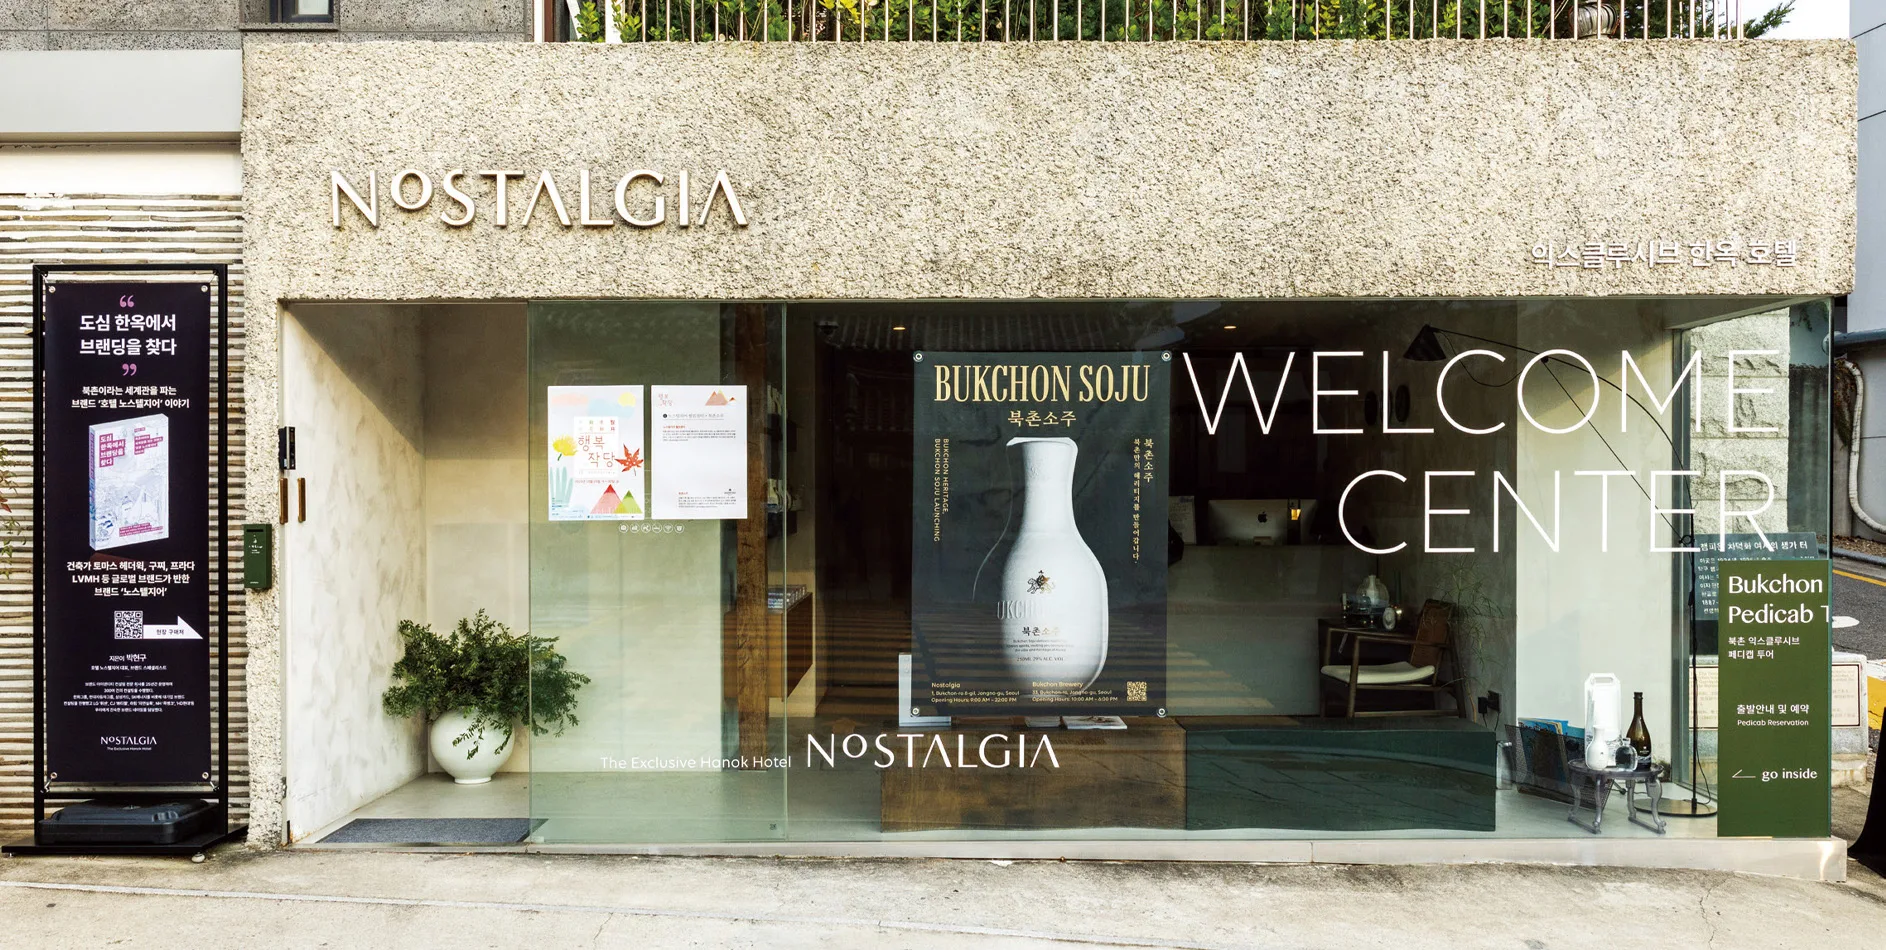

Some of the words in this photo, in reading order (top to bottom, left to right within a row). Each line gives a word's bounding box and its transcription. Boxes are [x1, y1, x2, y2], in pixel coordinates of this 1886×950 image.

[1531, 240, 1682, 271] 익스클루시브
[1689, 239, 1739, 268] 한옥
[1749, 240, 1797, 269] 호텔
[79, 314, 111, 332] 도심
[114, 313, 177, 332] 한옥에서
[79, 338, 142, 356] 브랜딩을
[145, 338, 177, 356] 찾다
[82, 385, 124, 396] 북촌이라는
[125, 385, 158, 396] 세계관을
[159, 385, 177, 396] 파는
[934, 364, 1071, 403] BUKCHON
[1079, 364, 1150, 403] SOJU
[1182, 348, 1780, 435] WELCOME
[71, 398, 97, 409] 브랜드
[164, 398, 190, 409] 이야기
[1007, 410, 1077, 428] 북촌소주
[578, 435, 605, 452] 행복
[588, 452, 615, 468] 작당
[942, 438, 950, 475] BUKCHON
[1143, 438, 1154, 483] 북촌소주
[1338, 469, 1777, 554] CENTER
[1781, 540, 1797, 550] 생가
[1799, 540, 1808, 549] 터
[66, 561, 92, 571] 건축가
[93, 561, 118, 571] 토마스
[148, 561, 169, 572] 구찌,
[170, 561, 195, 571] 프라다
[72, 574, 100, 584] LVMH
[101, 574, 111, 584] 등
[111, 574, 137, 584] 글로벌
[137, 574, 172, 584] 브랜드가
[173, 574, 190, 584] 반한
[1728, 573, 1823, 594] Bukchon
[94, 587, 120, 597] 브랜드
[1728, 603, 1814, 624] Pedicab
[1728, 636, 1745, 646] 북촌
[1748, 636, 1800, 646] 익스클루시브
[1728, 650, 1754, 659] 페디캡
[1756, 650, 1774, 660] 투어
[931, 682, 961, 690] Nostalgia
[1058, 681, 1084, 689] Brewery
[1737, 703, 1774, 715] 출발안내
[1778, 704, 1787, 715] 및
[1790, 703, 1809, 715] 예약
[1737, 719, 1766, 727] Pedicab
[1767, 719, 1809, 727] Reservation
[600, 755, 627, 769] The
[631, 755, 697, 769] Exclusive
[700, 755, 749, 769] Hanok
[752, 755, 792, 769] Hotel
[1761, 770, 1778, 782] go
[1782, 767, 1818, 779] inside
